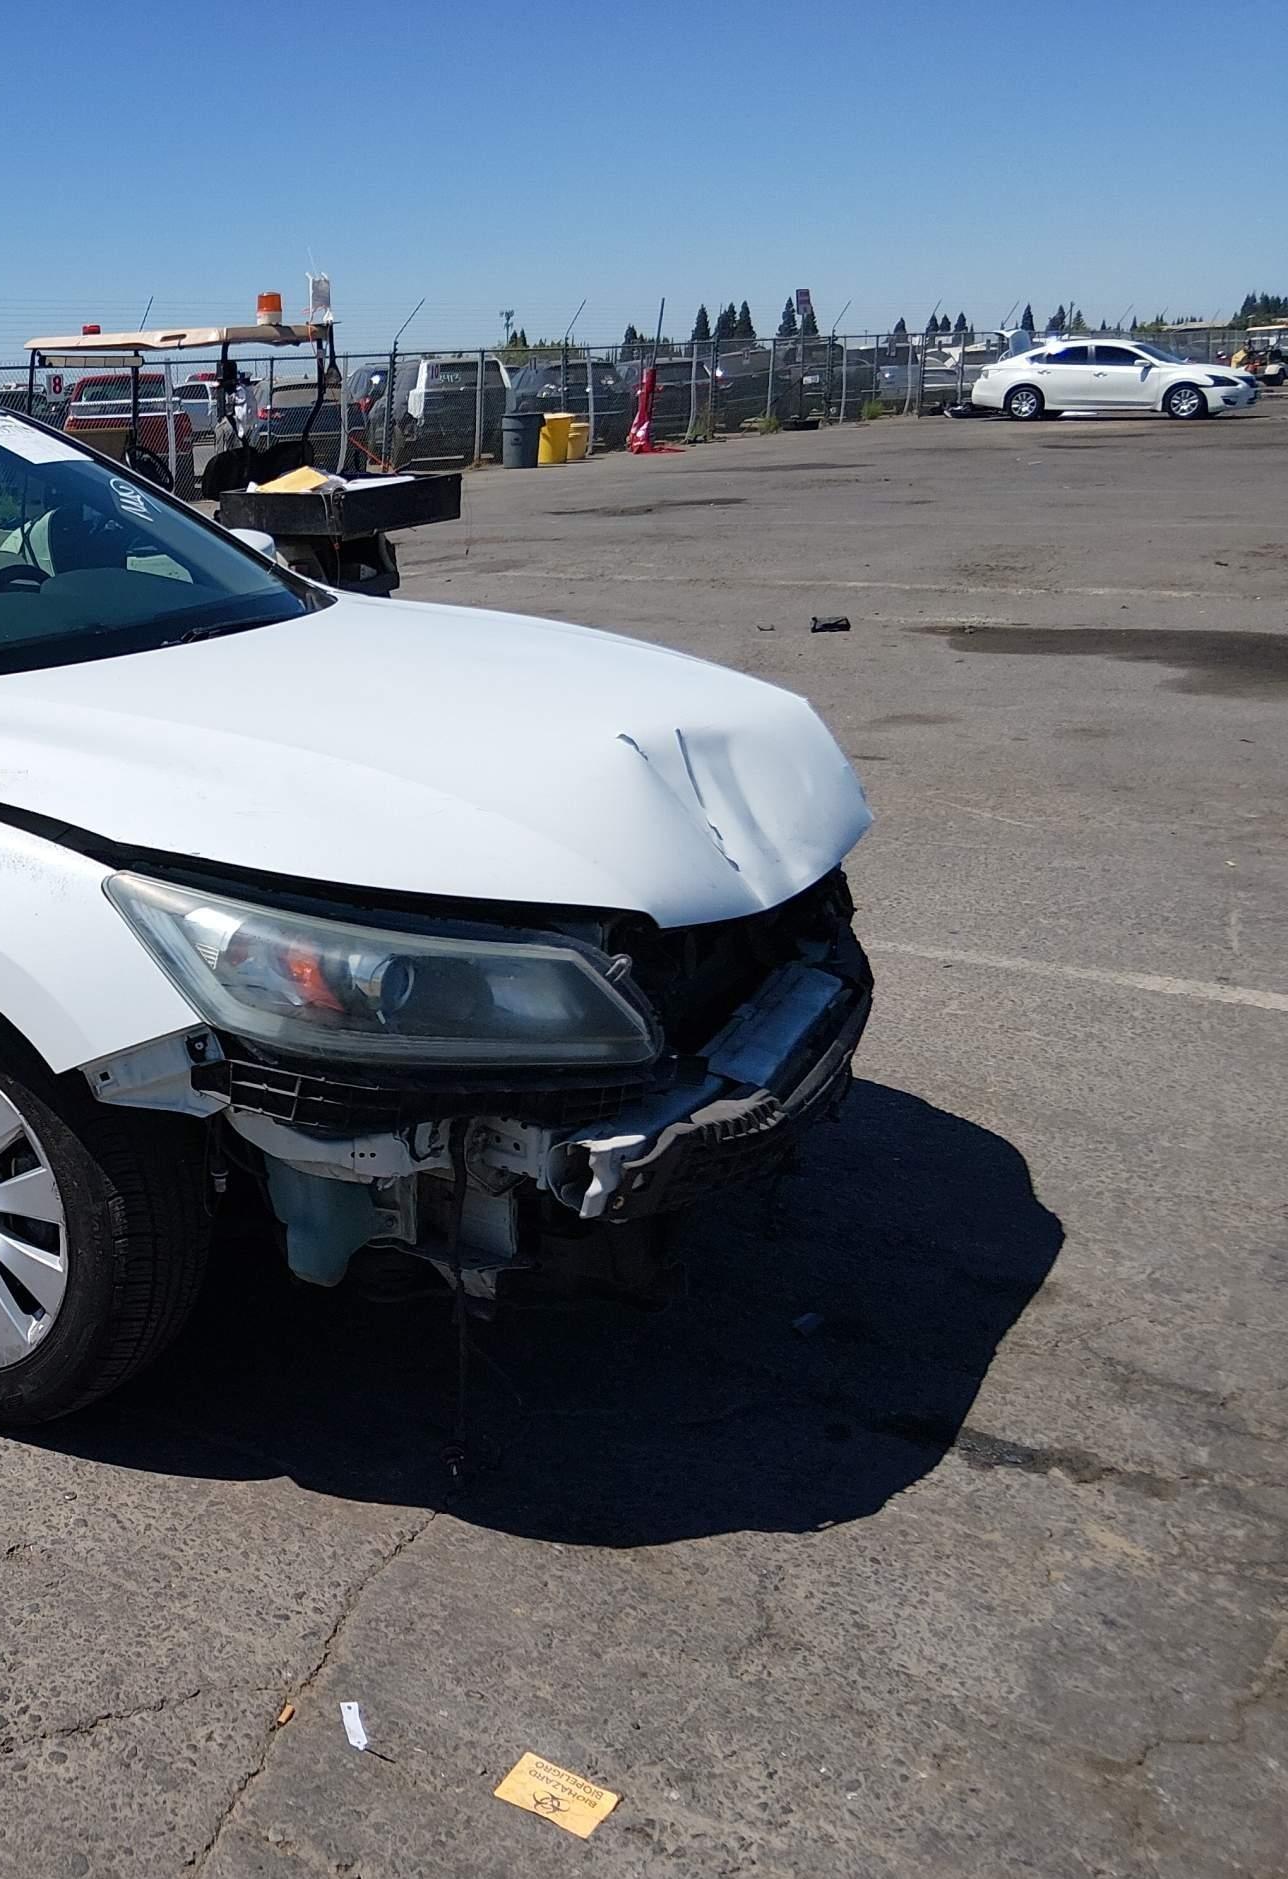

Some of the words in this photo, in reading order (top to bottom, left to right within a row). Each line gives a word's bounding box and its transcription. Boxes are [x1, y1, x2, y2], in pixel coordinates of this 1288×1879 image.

[52, 375, 62, 395] 8
[528, 1769, 597, 1809] BIOHAZARD
[535, 1761, 604, 1800] BIOPELIGRO
